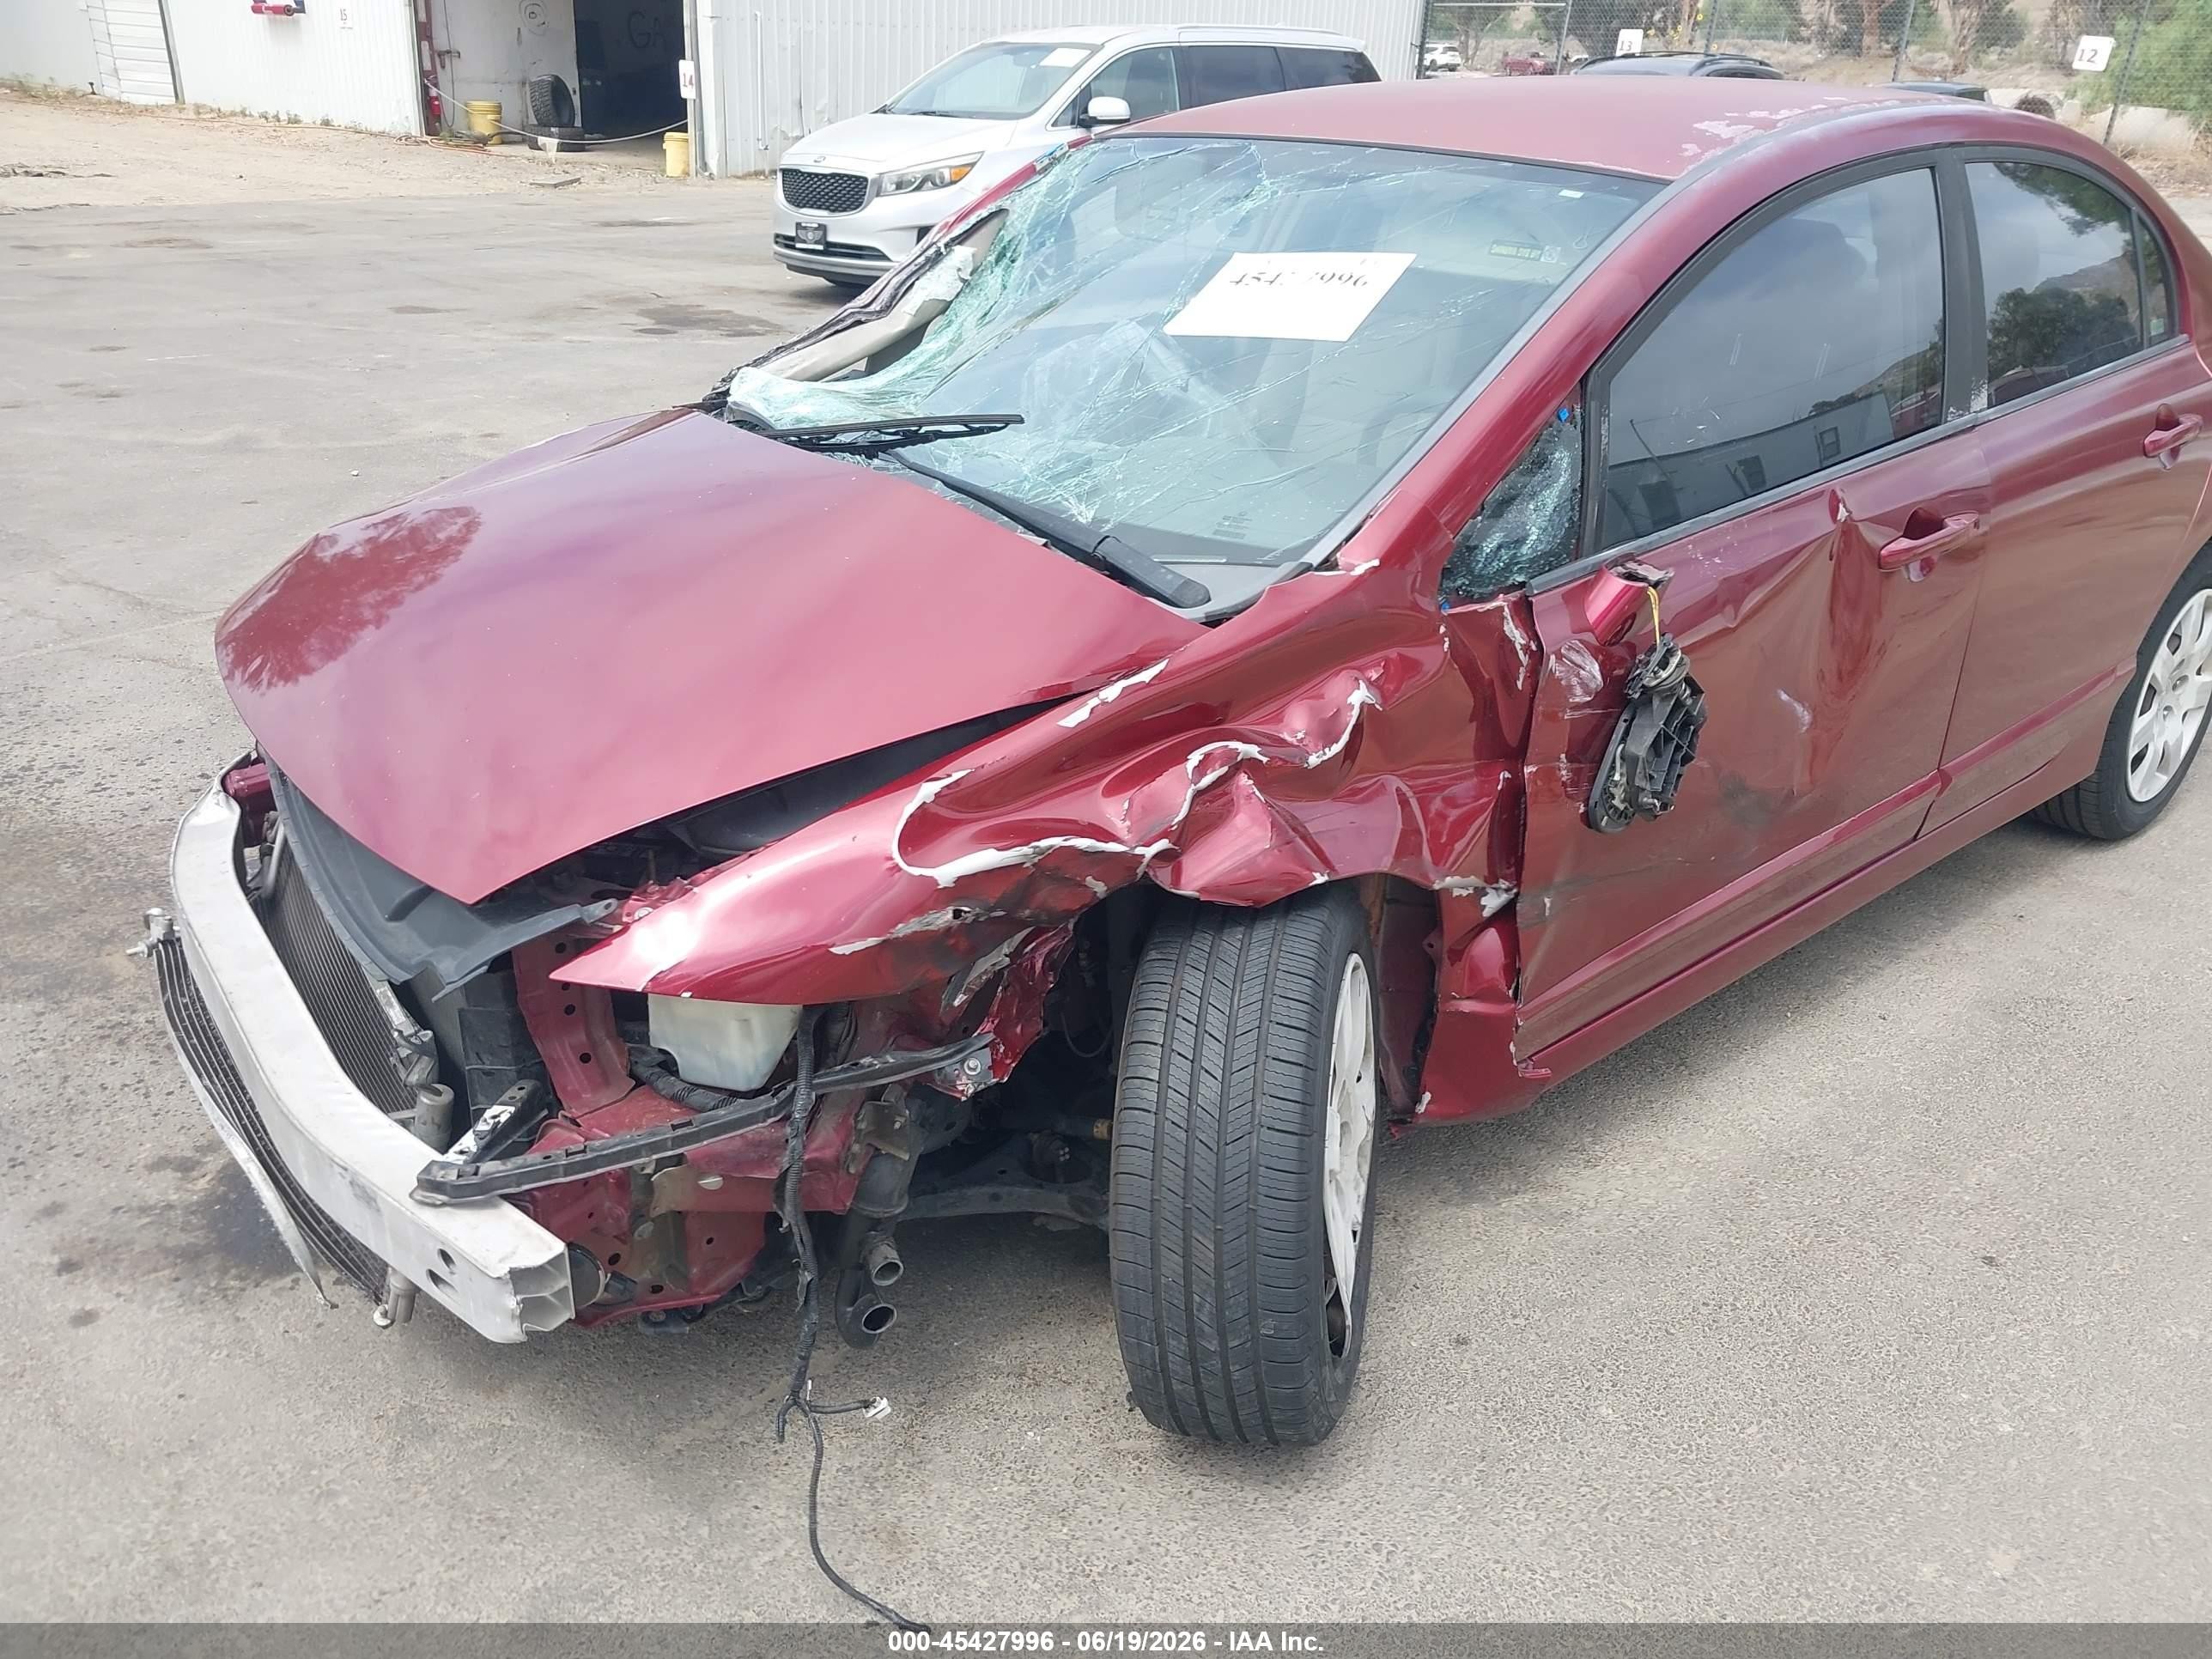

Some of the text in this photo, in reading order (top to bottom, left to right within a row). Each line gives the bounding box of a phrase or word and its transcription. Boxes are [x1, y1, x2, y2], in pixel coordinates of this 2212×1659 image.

[1619, 40, 1632, 52] 13
[2078, 48, 2098, 63] 12
[683, 72, 694, 89] 14
